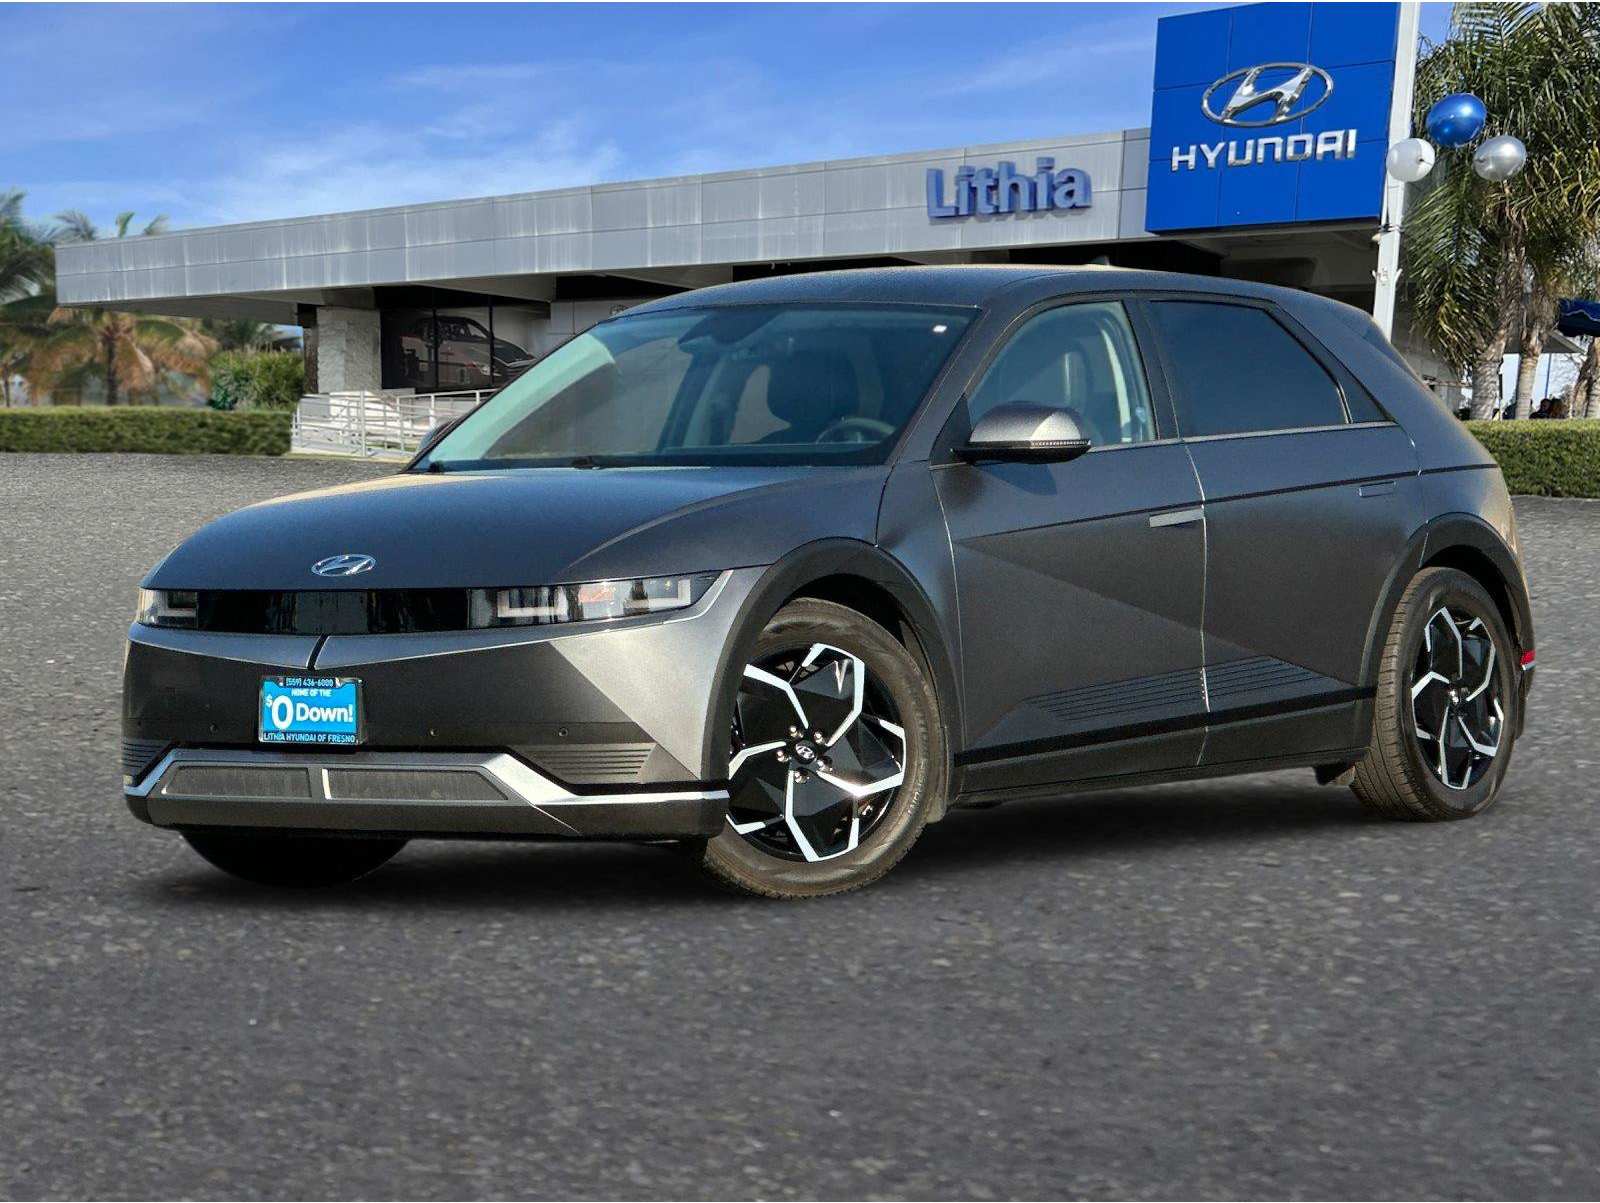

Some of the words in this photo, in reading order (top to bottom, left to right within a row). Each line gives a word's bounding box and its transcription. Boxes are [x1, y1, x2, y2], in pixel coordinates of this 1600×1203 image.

[1171, 129, 1358, 171] HYUNDAI
[926, 157, 1092, 218] Lithia
[303, 679, 333, 687] 436-6000
[291, 688, 309, 697] HOME
[309, 689, 318, 697] OF
[319, 689, 332, 697] THE
[296, 702, 354, 723] Down!
[286, 733, 316, 742] HYUNDAI
[317, 734, 327, 742] OF
[328, 734, 355, 743] FRESNO
